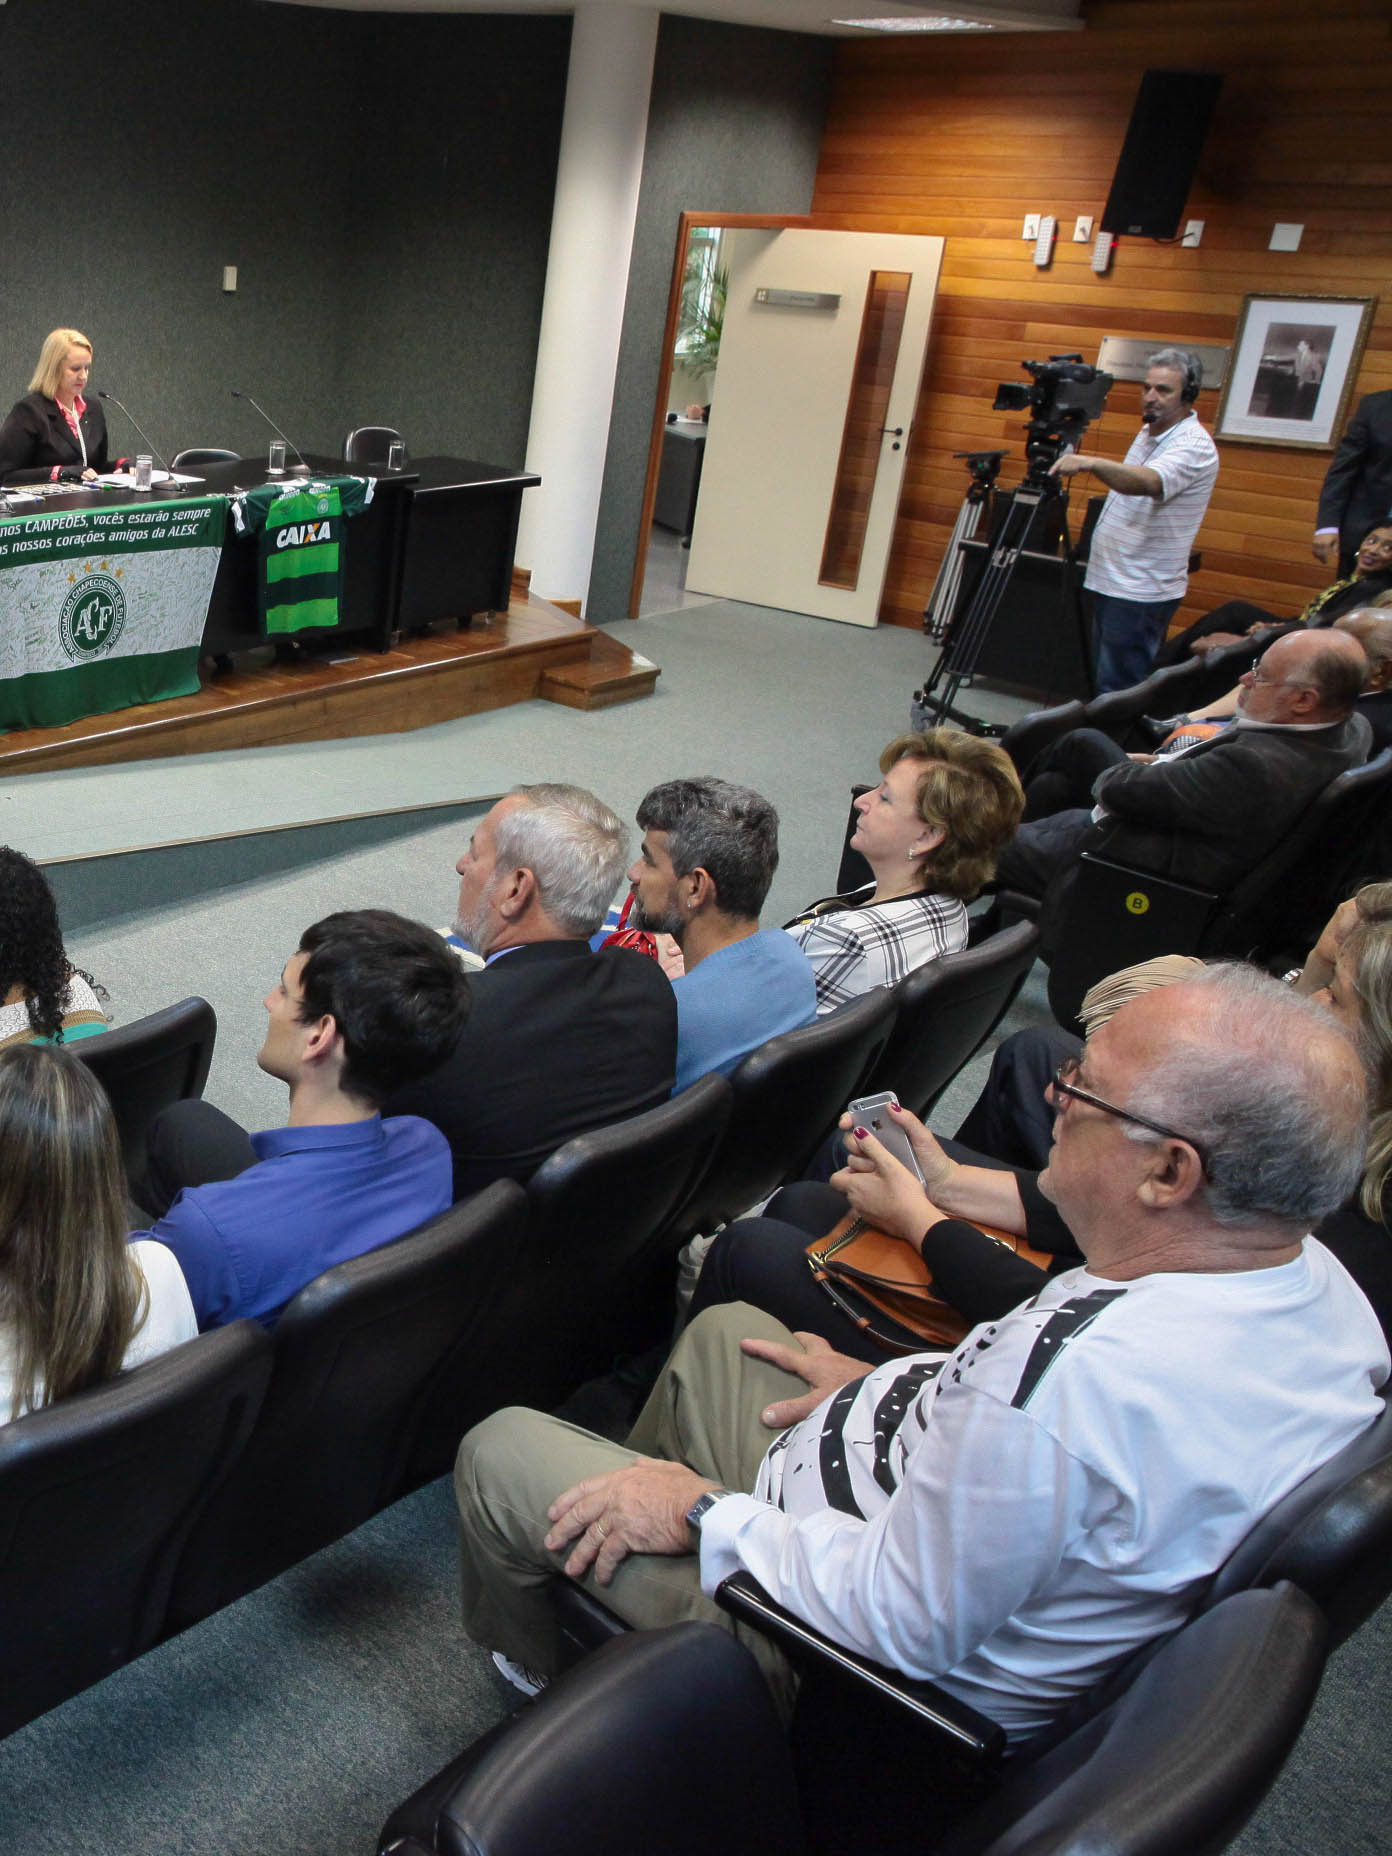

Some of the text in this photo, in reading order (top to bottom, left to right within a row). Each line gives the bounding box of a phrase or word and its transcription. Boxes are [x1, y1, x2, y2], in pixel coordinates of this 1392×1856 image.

[25, 514, 89, 533] CAMPEÕES,
[93, 511, 124, 526] vocês
[128, 510, 169, 524] estarão
[172, 508, 211, 522] sempre
[12, 539, 52, 553] nossos
[56, 530, 105, 547] corações
[108, 527, 149, 543] amigos
[151, 526, 165, 538] da
[168, 523, 199, 537] ALESC
[276, 521, 331, 548] CAIXA
[1132, 897, 1143, 909] B
